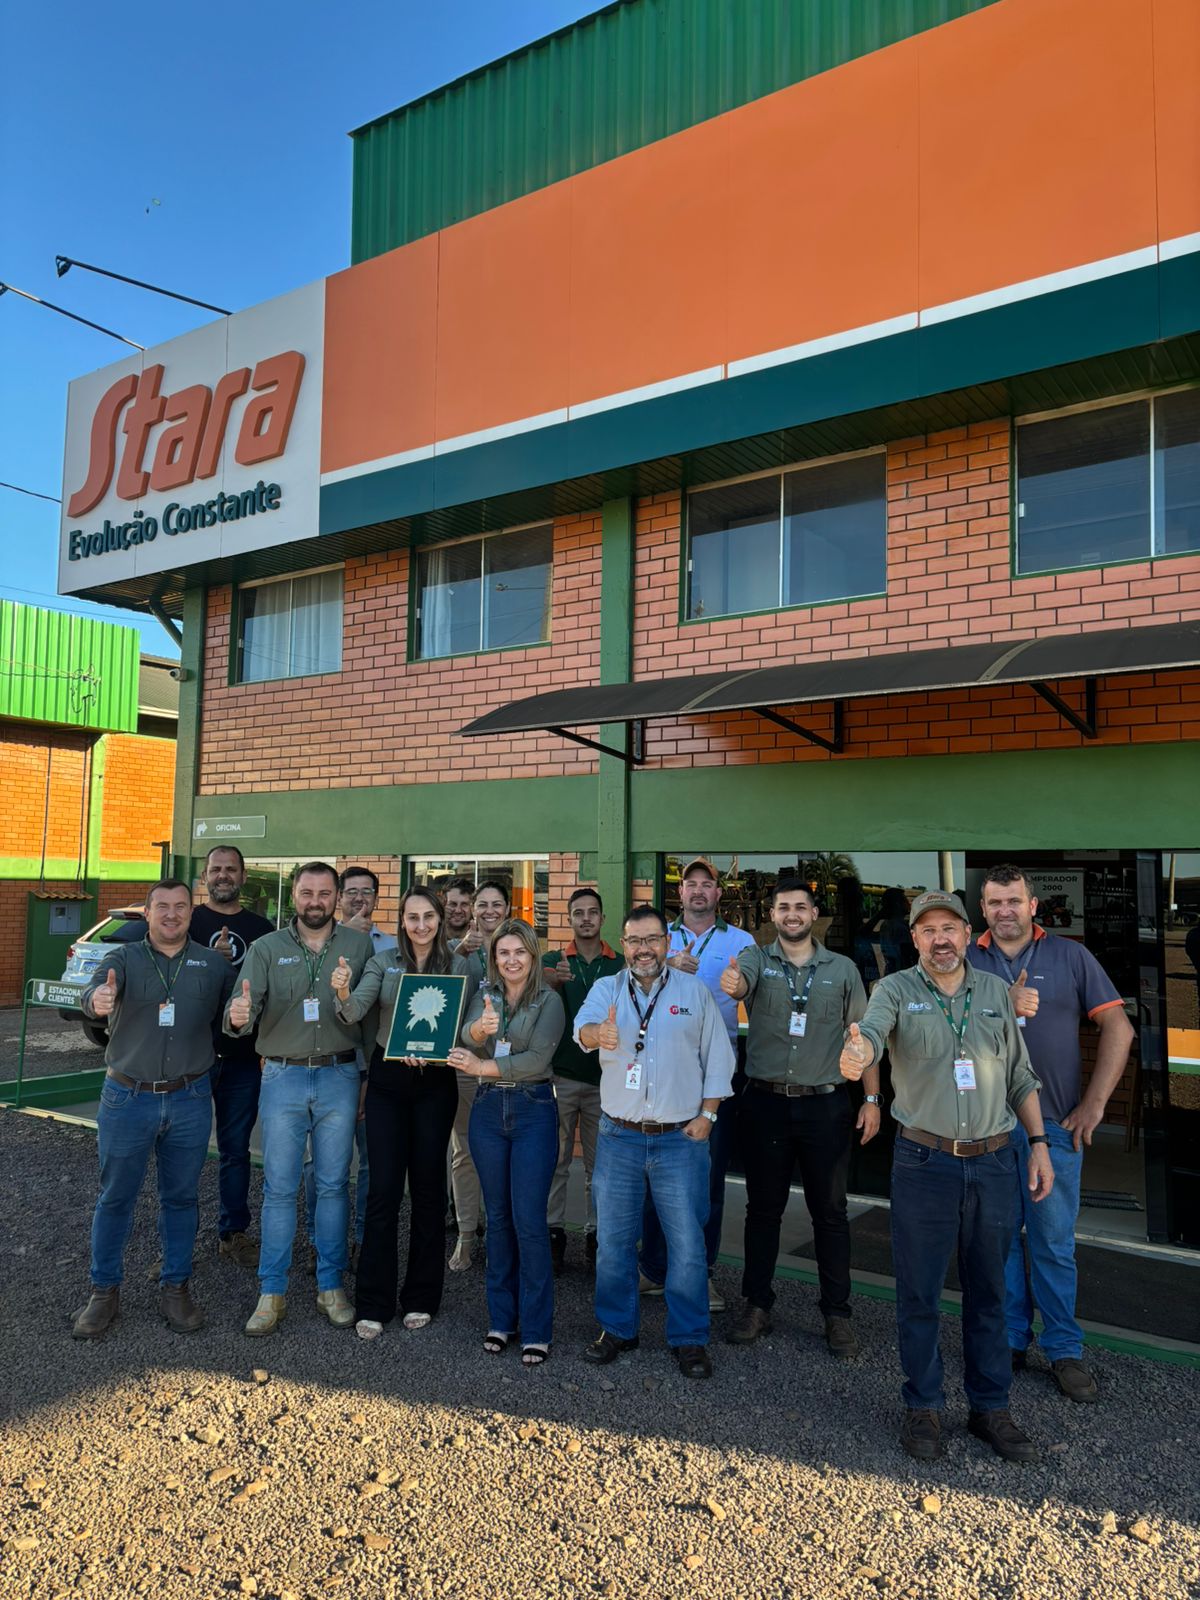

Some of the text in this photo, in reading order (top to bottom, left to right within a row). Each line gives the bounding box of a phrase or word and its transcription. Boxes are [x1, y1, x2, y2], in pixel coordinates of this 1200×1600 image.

[67, 350, 306, 518] Stara
[68, 480, 282, 561] Evolução Constante
[215, 823, 242, 832] OFICINA
[1029, 875, 1078, 883] MPERADOR
[48, 985, 82, 997] ESTACIONA
[48, 994, 75, 1004] CLIENTES
